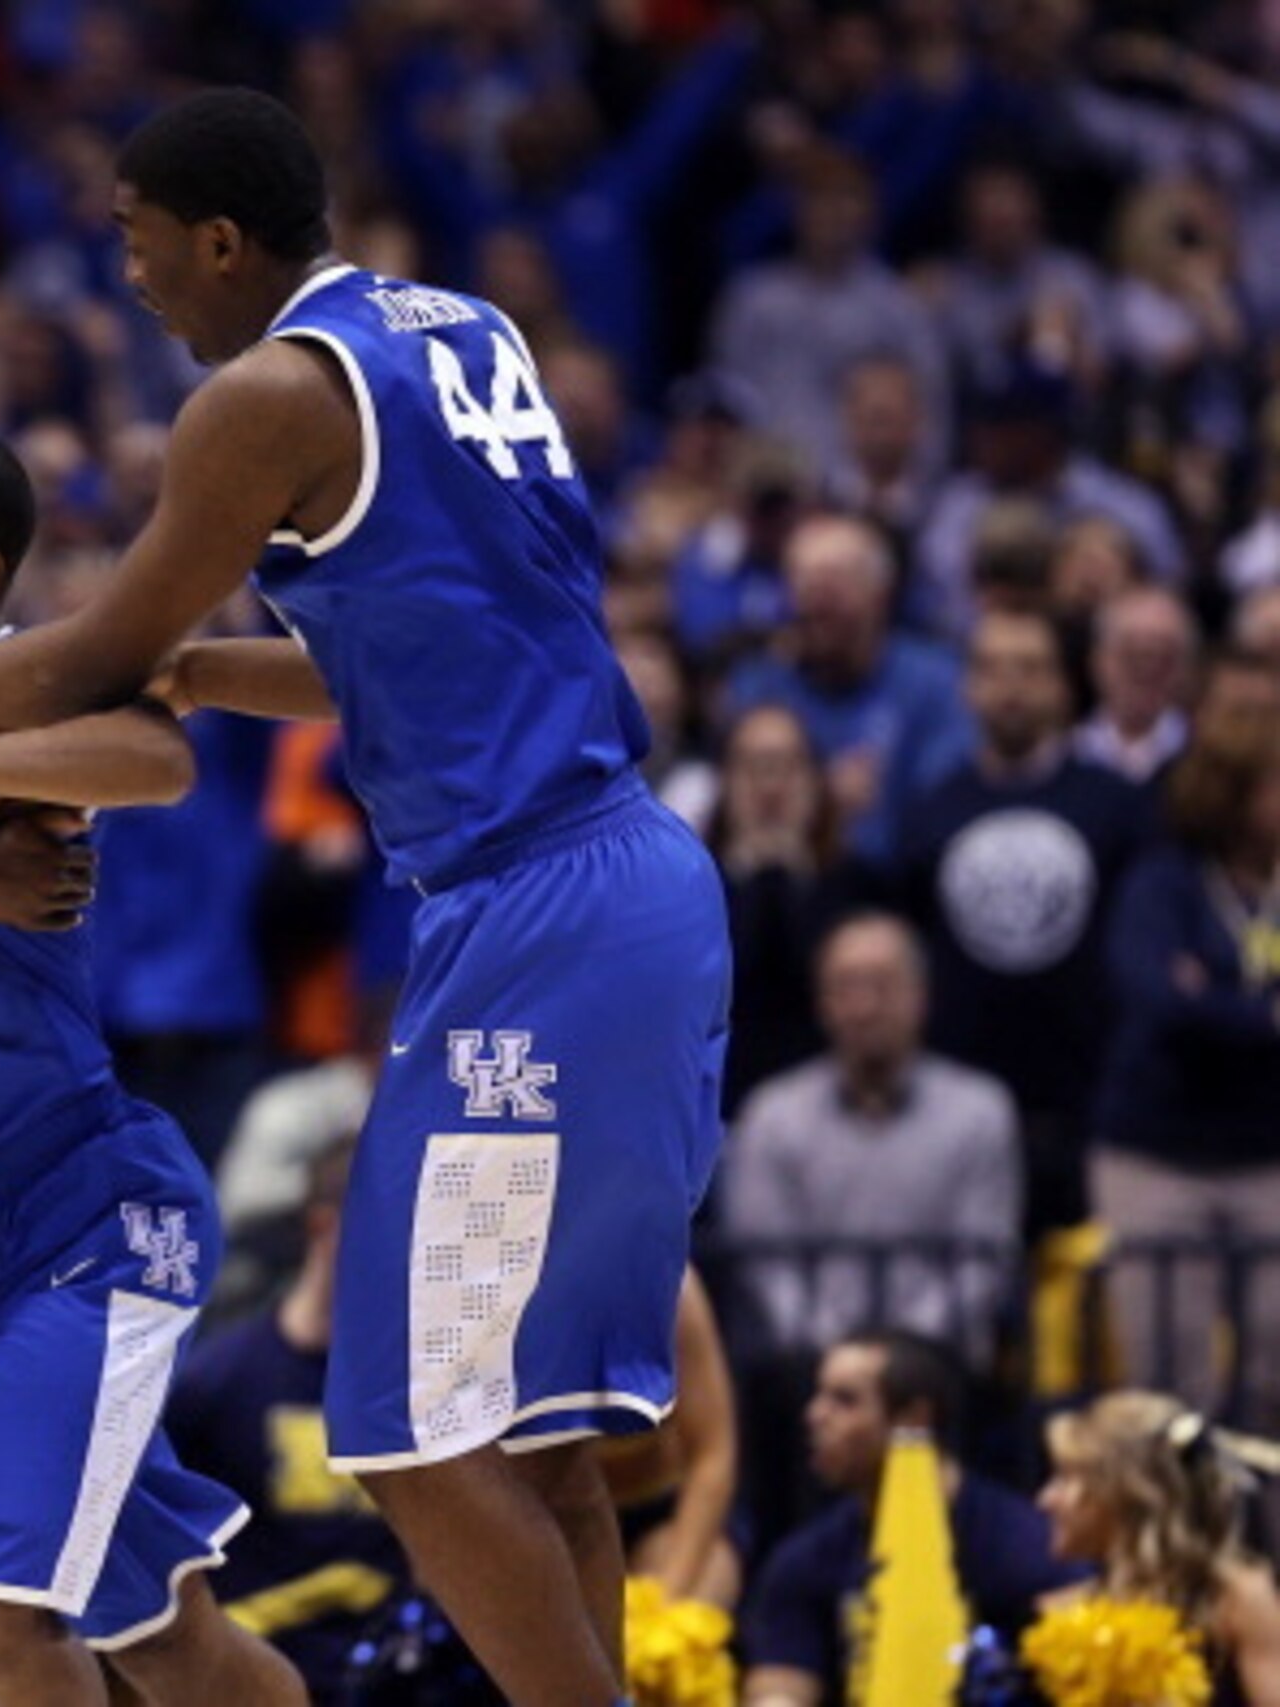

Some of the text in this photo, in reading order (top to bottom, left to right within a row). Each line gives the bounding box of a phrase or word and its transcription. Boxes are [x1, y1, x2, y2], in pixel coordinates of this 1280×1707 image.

[427, 331, 573, 479] 44
[447, 1029, 557, 1121] UK
[120, 1202, 199, 1299] UK
